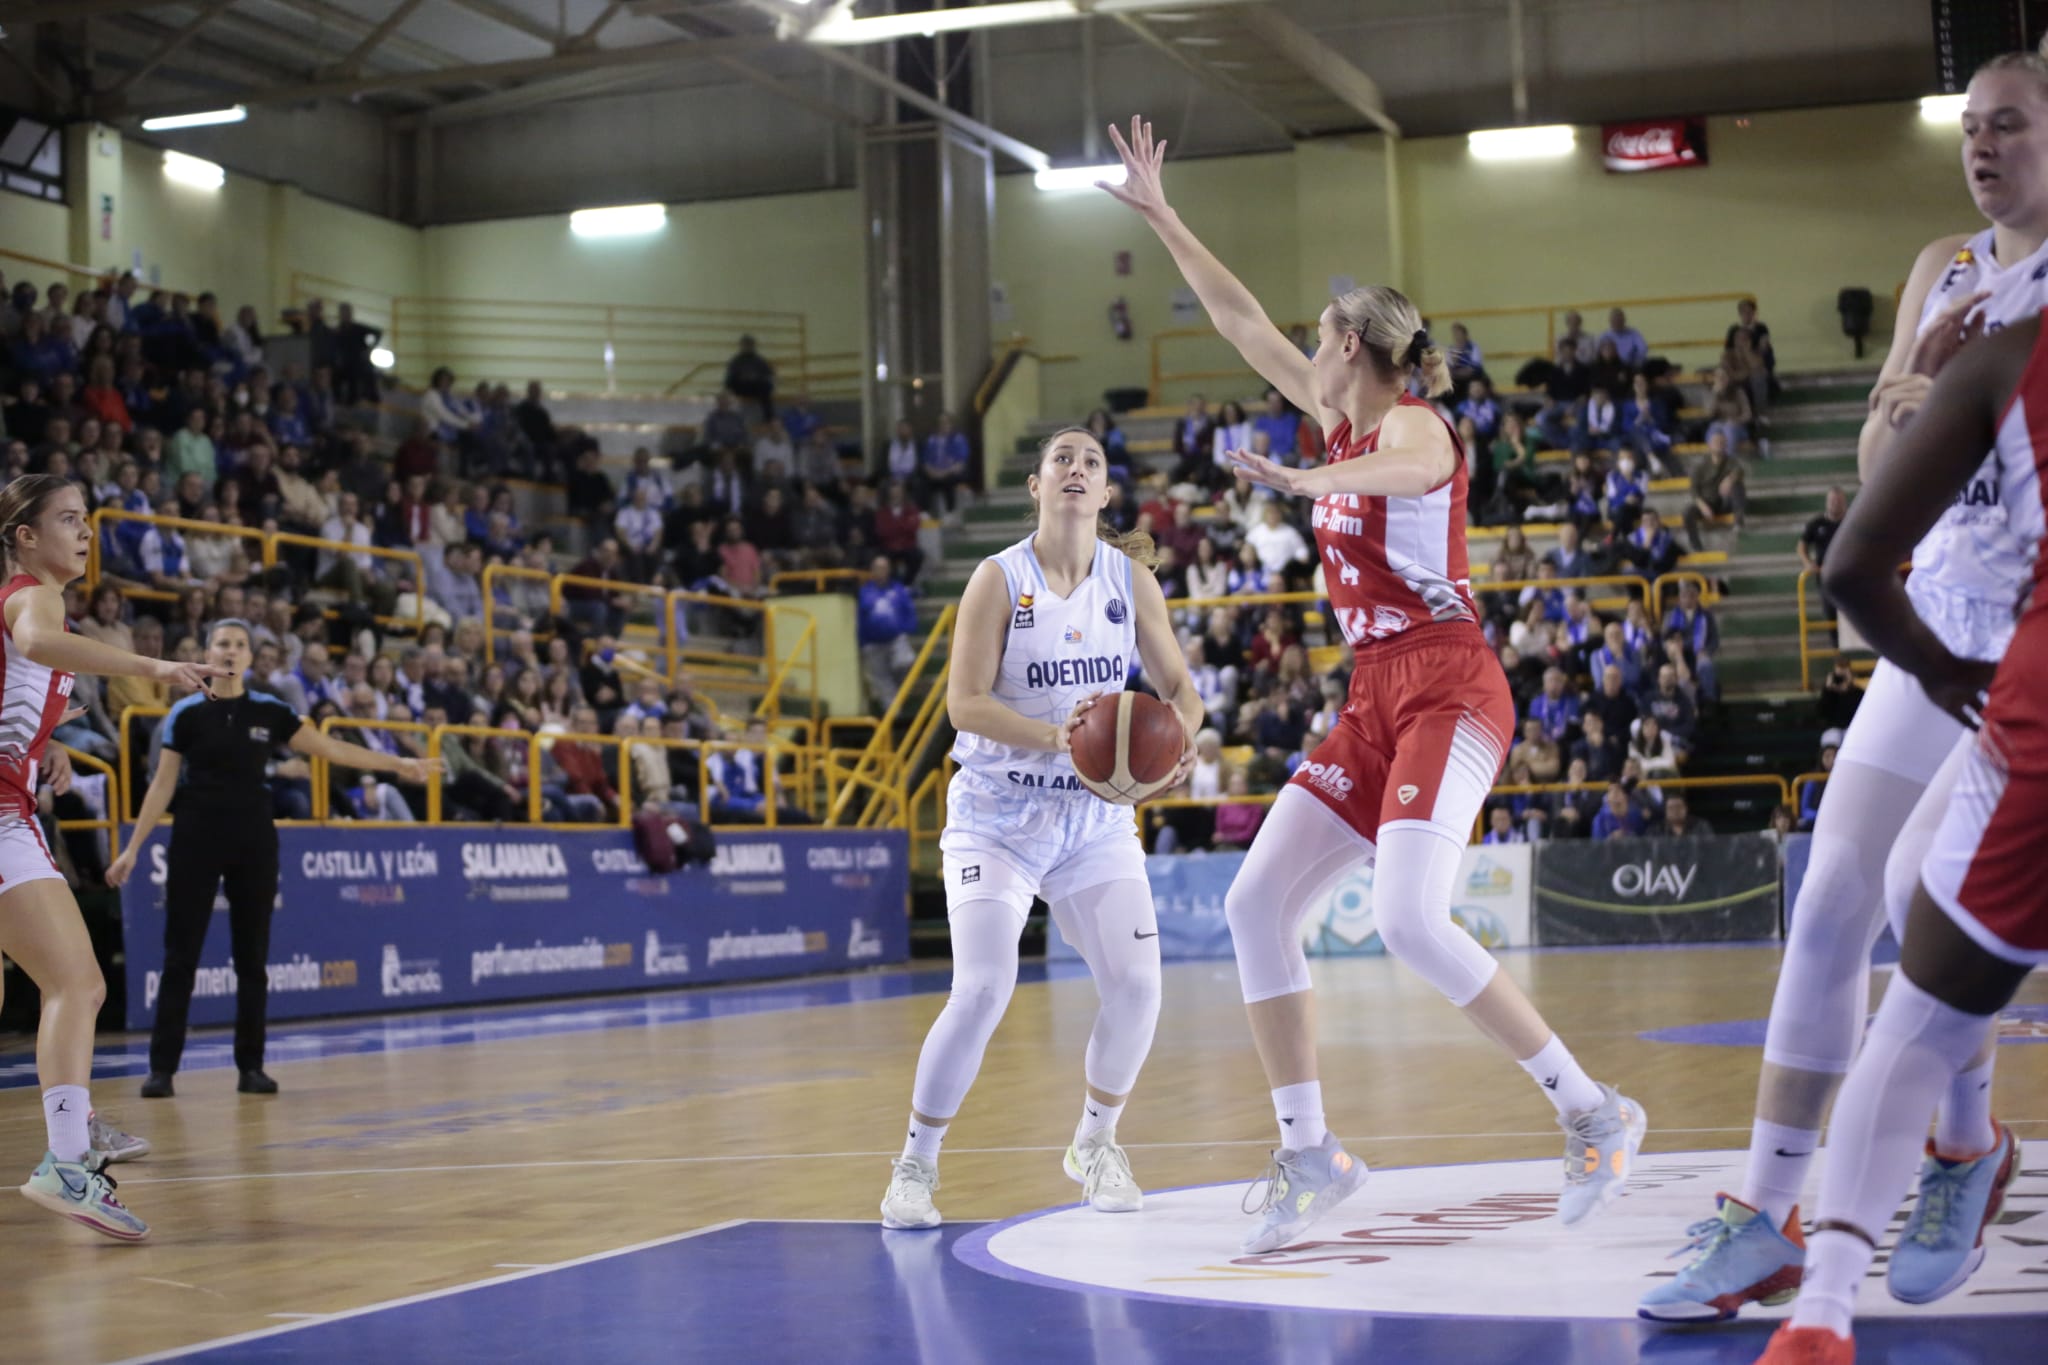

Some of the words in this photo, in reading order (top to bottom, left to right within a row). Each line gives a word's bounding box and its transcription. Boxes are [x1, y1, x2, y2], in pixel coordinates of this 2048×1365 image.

[1027, 655, 1123, 688] AVENIDA
[1007, 770, 1087, 791] SALAM
[301, 850, 378, 878] CASTILLA
[381, 850, 394, 881] Y
[396, 842, 438, 877] LEÓN
[462, 843, 568, 878] SALAMANCA
